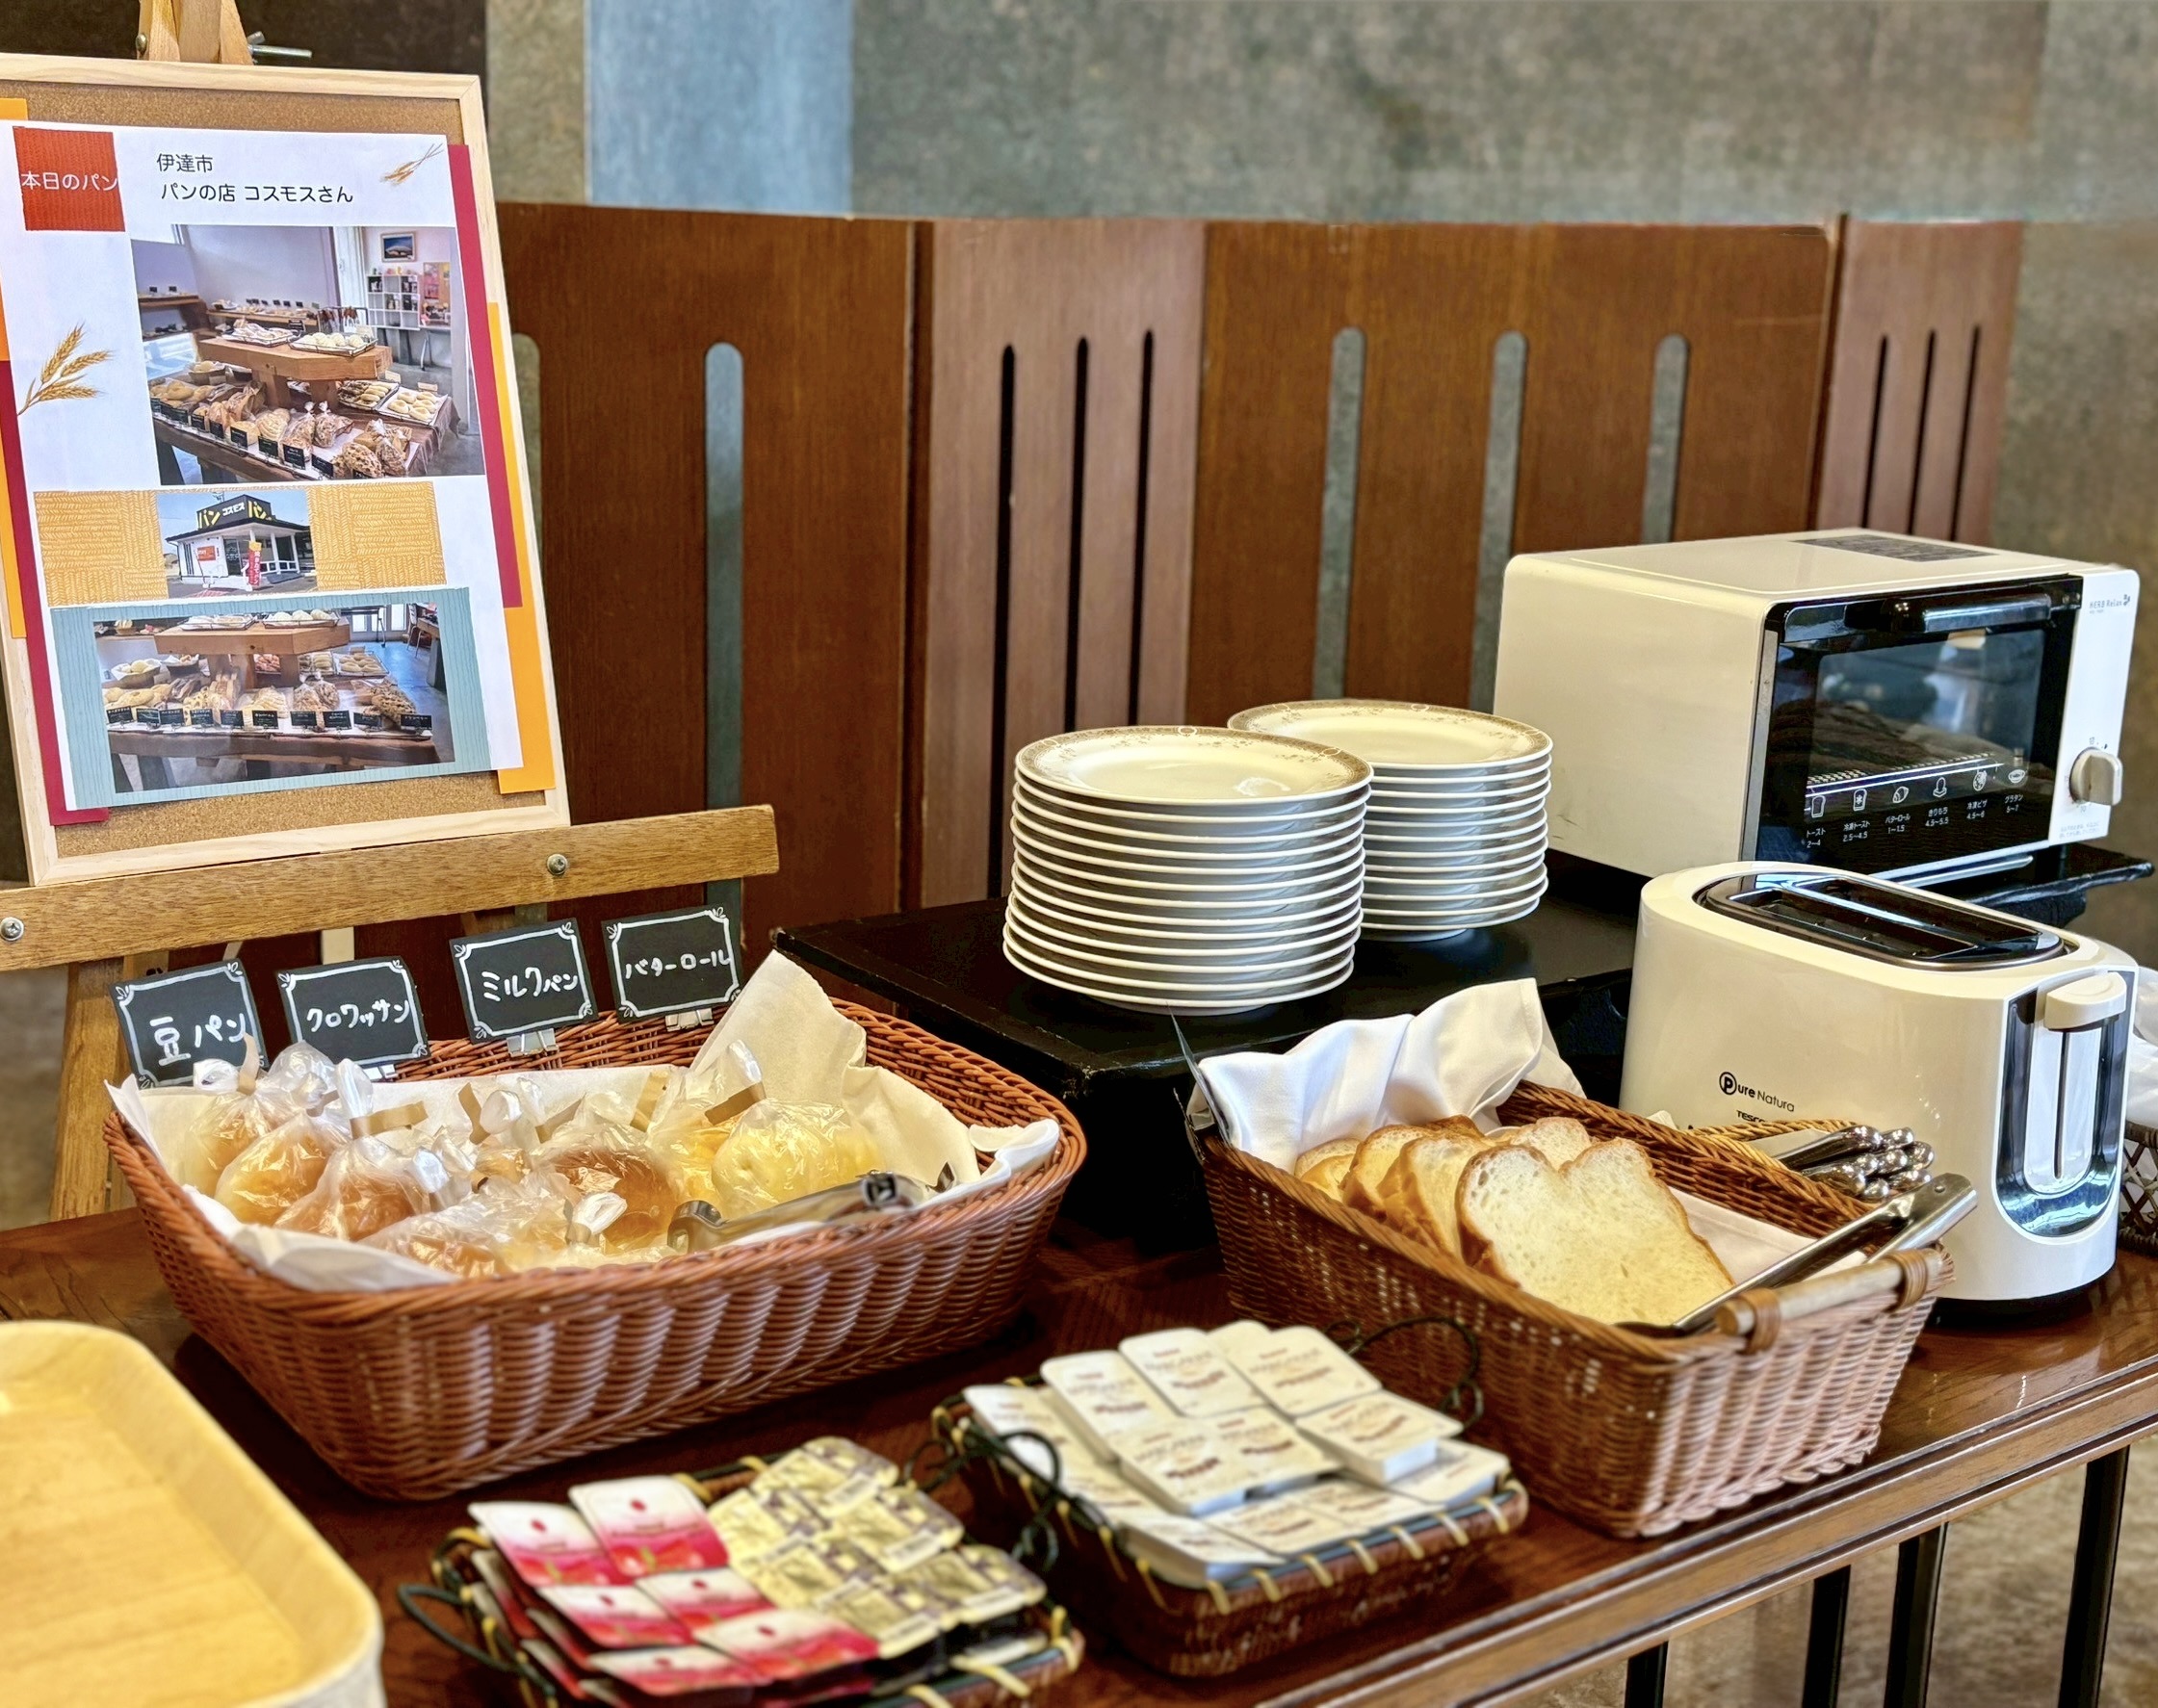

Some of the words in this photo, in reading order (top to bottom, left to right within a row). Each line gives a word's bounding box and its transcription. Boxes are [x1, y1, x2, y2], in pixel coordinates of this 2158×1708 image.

[156, 153, 214, 173] 伊達市
[20, 172, 117, 192] 本日のパン
[161, 184, 236, 202] パンの店
[244, 186, 353, 204] コスモスさん
[198, 509, 221, 529] パン
[625, 949, 731, 979] バターロール
[481, 967, 578, 1001] ミルクパン
[306, 998, 410, 1032] クロワッサン
[1719, 1071, 1755, 1099] Pure
[1756, 1090, 1795, 1112] Natura
